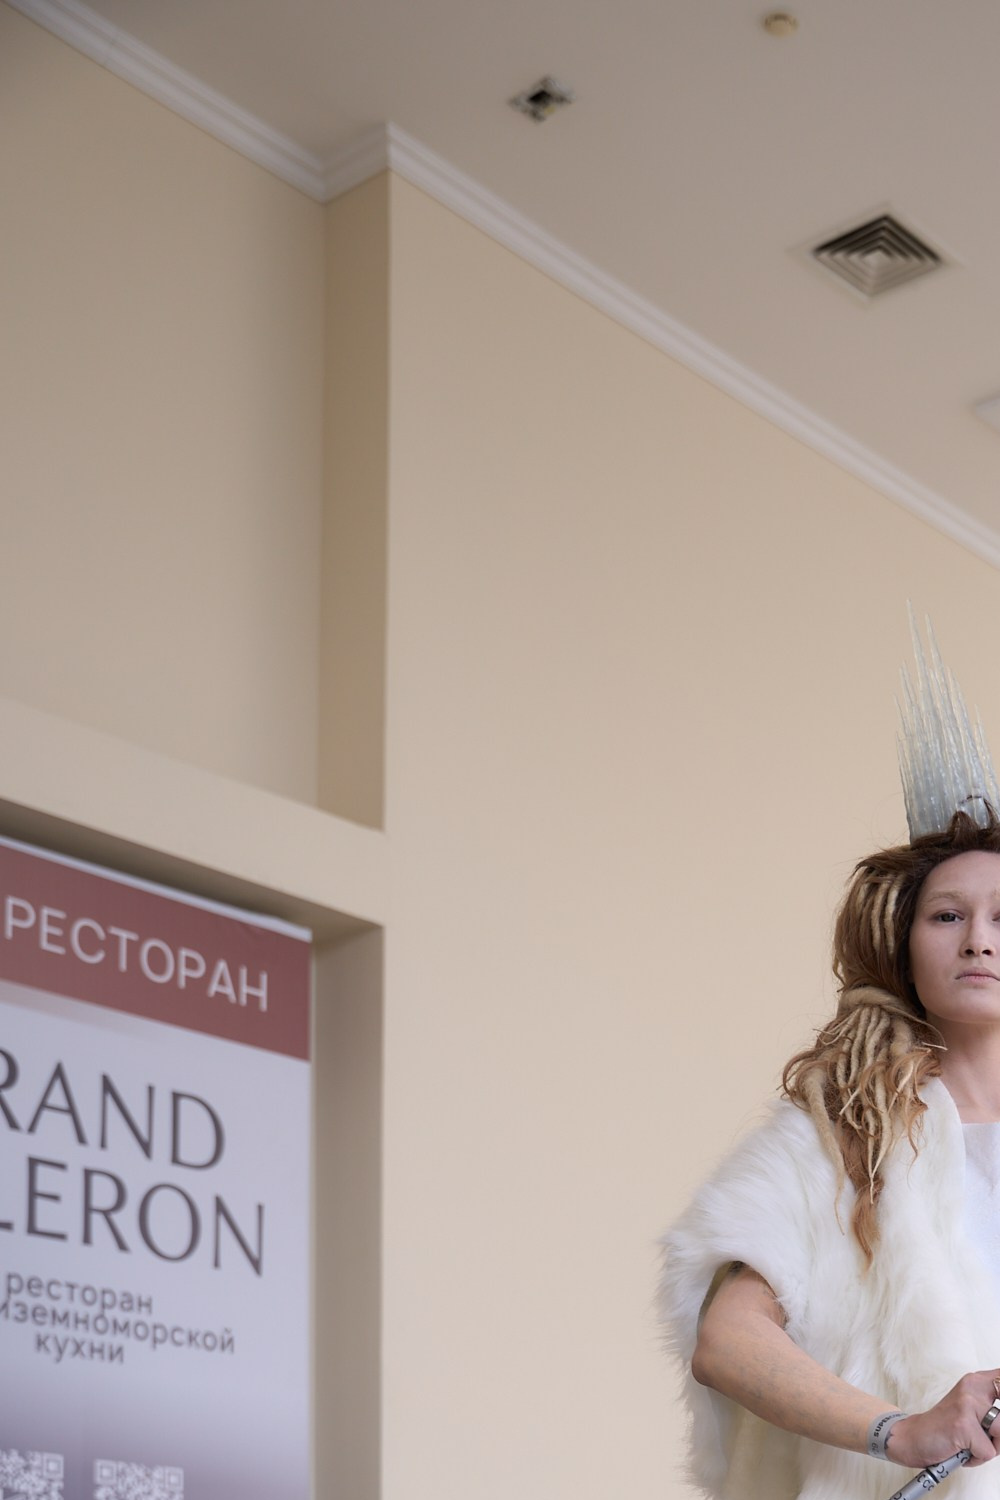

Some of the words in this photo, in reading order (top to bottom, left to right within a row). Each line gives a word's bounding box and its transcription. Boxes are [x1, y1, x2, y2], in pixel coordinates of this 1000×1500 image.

[3, 895, 268, 1012] РЕСТОРАН
[0, 1154, 265, 1278] ERON
[5, 1272, 153, 1316] ресторан
[35, 1333, 125, 1364] кухни
